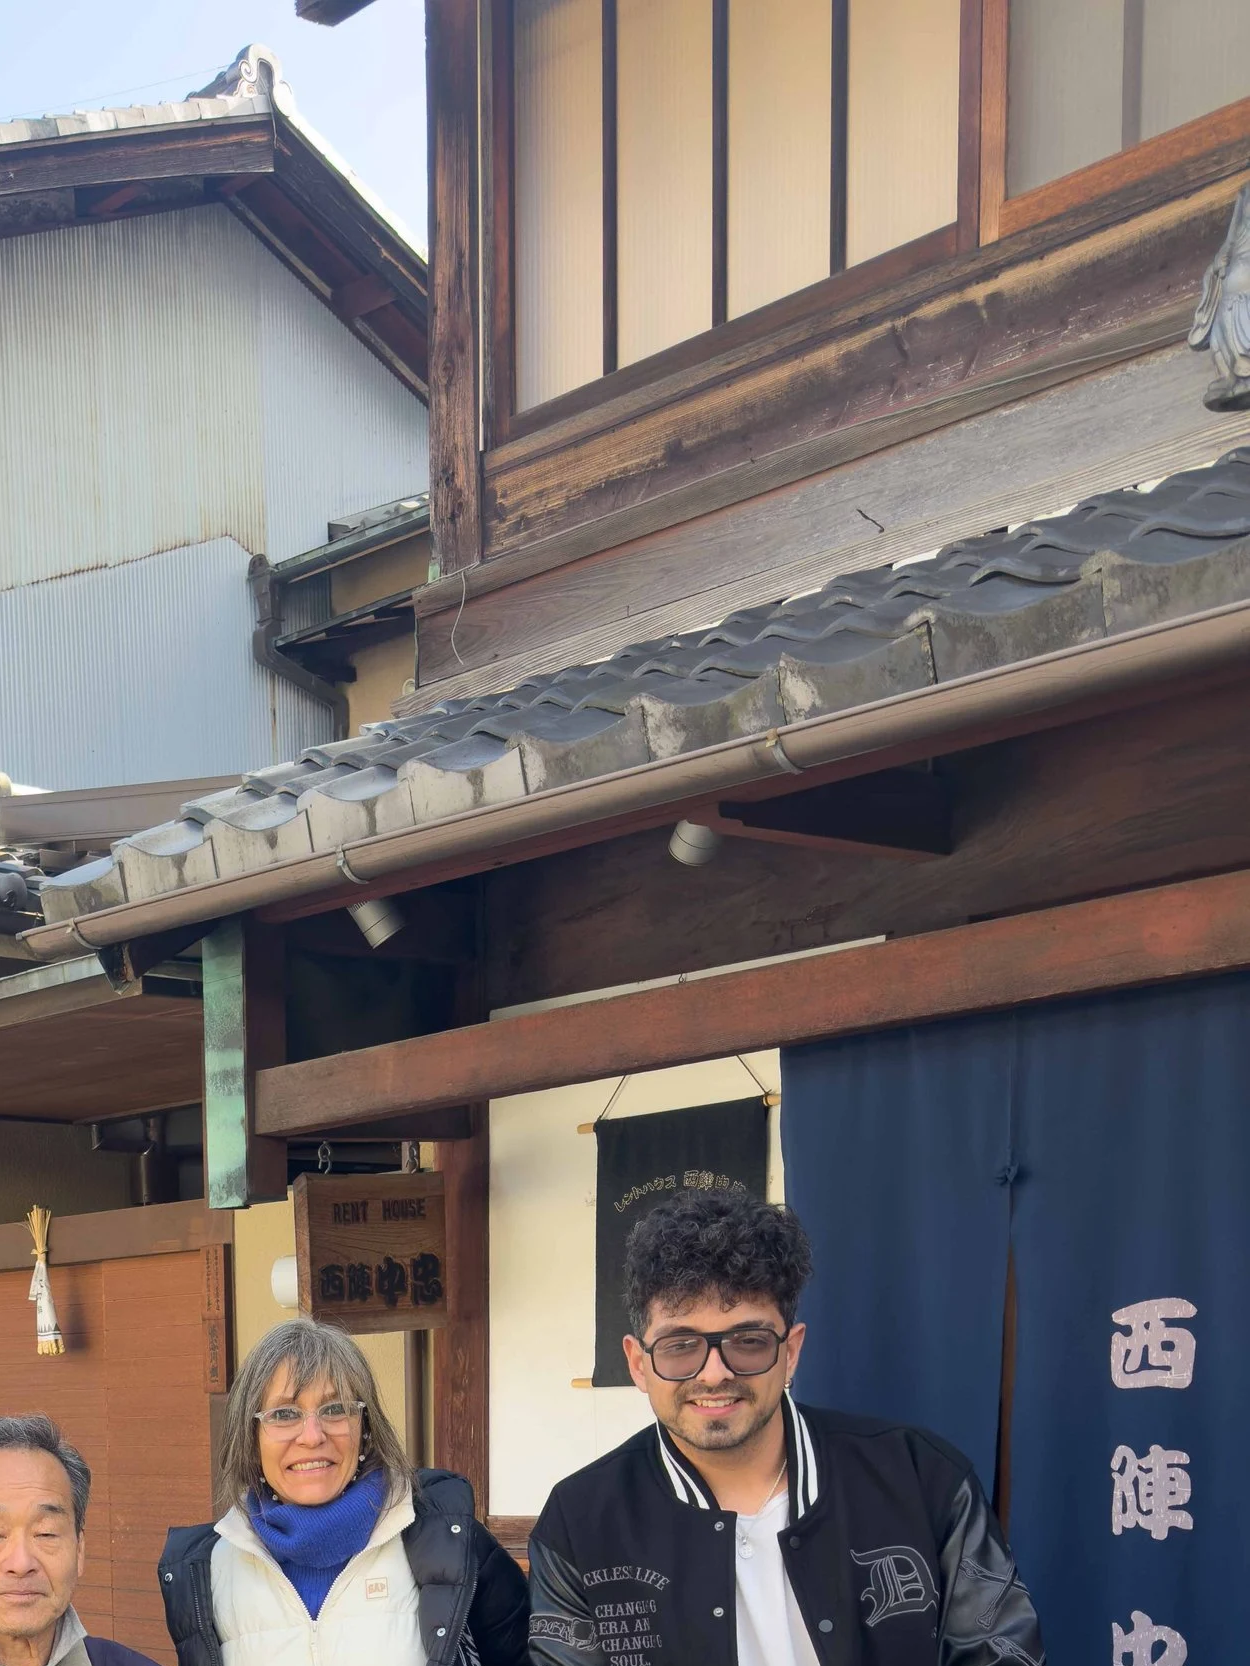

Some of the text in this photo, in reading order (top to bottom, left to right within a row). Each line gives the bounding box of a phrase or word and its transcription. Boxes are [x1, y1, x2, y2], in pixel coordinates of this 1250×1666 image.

[614, 1175, 676, 1212] レントハウス
[333, 1198, 426, 1223] RENT HOUSE
[583, 1566, 670, 1590] CKLES LIFE
[599, 1617, 650, 1635] ERA AN
[602, 1634, 663, 1652] CHANGIG
